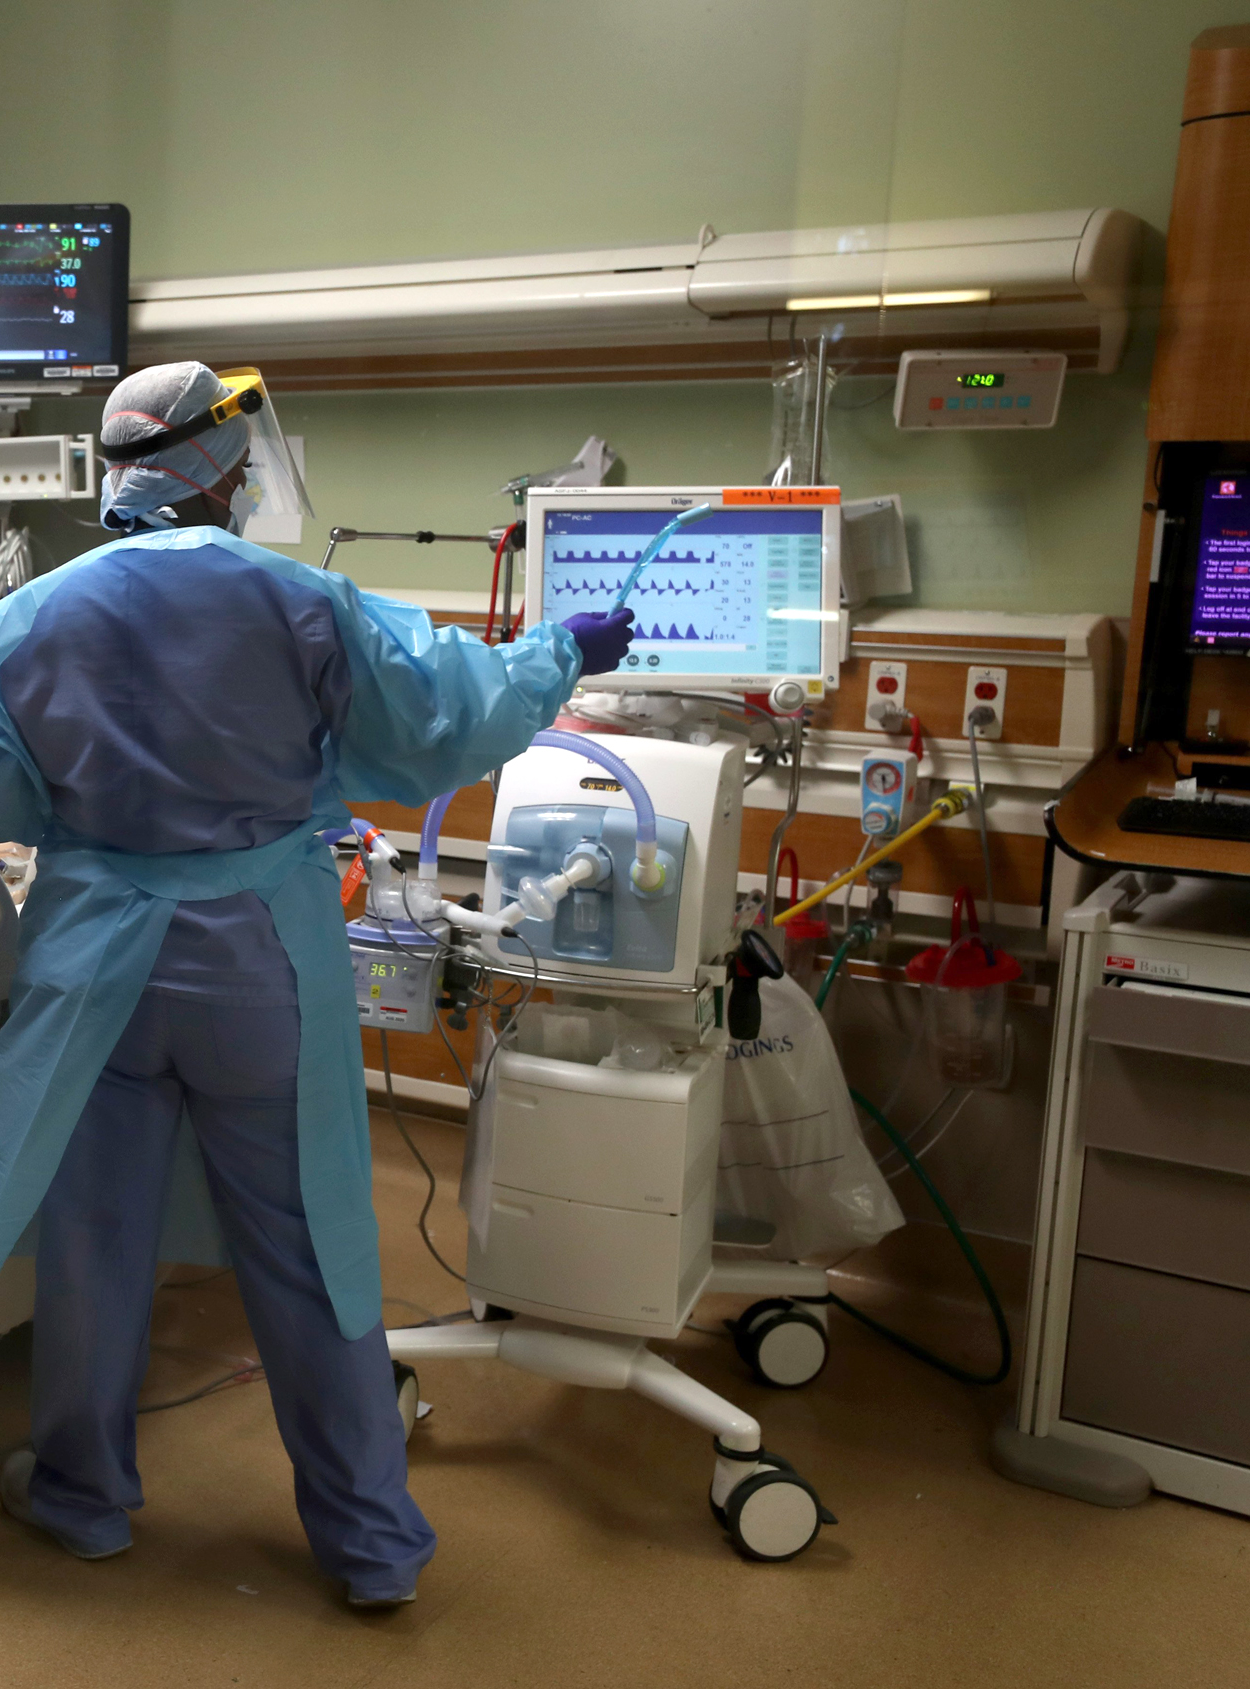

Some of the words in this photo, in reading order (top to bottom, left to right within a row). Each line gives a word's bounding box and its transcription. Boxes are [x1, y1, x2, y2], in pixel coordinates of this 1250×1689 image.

[61, 236, 76, 251] 91
[60, 258, 81, 270] 37.0
[59, 310, 75, 324] 28
[768, 491, 792, 502] V-1
[1140, 961, 1180, 977] Basix
